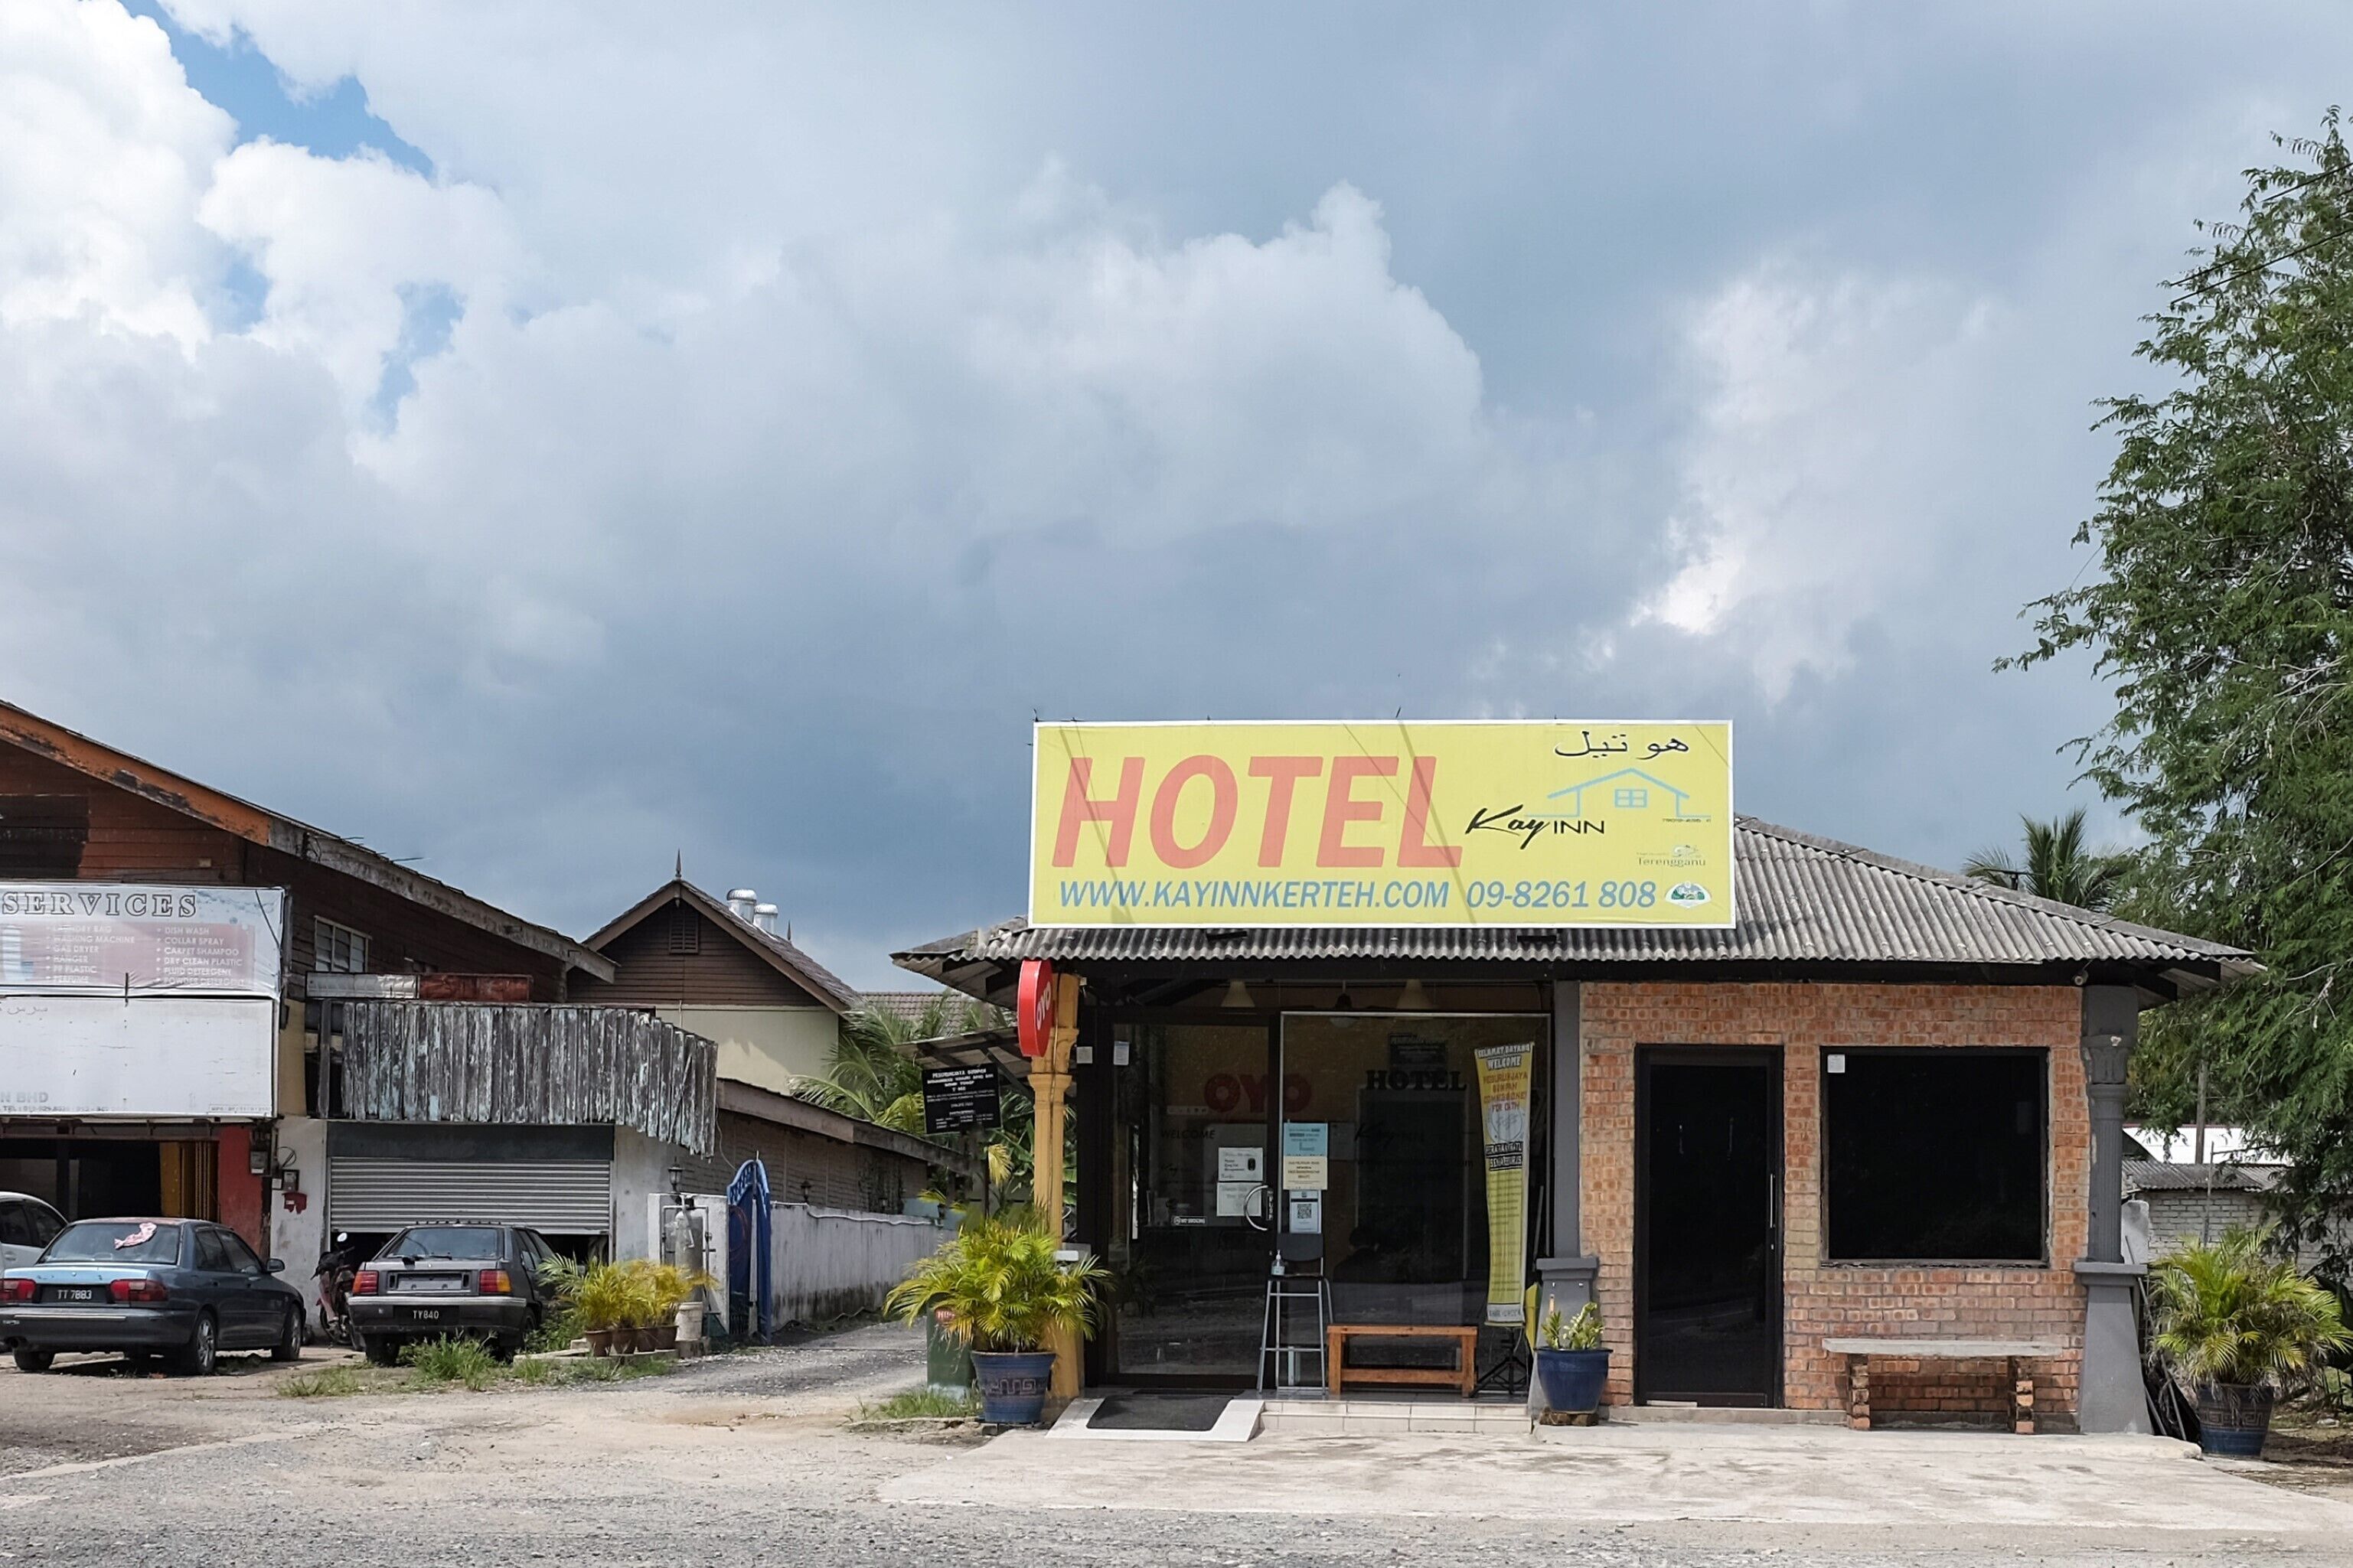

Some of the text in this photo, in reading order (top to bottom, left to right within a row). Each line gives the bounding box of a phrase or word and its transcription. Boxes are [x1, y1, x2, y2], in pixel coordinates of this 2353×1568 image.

[1636, 737, 1690, 760] هو
[1052, 755, 1463, 869] HOTEL
[1464, 804, 1604, 849] Kay INN
[1639, 856, 1706, 867] Terengganu
[2, 892, 196, 918] SERVICES
[1060, 881, 1450, 908] WWW.KAYINNKERTEH.COM
[1466, 881, 1657, 908] 09-8261 808
[65, 966, 97, 974] PLASTIC
[165, 957, 180, 965] DRY
[1036, 981, 1052, 1031] OYO
[1487, 1056, 1521, 1070] WELCOME
[1366, 1069, 1467, 1090] HOTEL
[1204, 1074, 1312, 1113] OYO
[1160, 1129, 1216, 1139] WELCOME
[57, 1289, 92, 1299] TT 7883
[413, 1309, 439, 1319] TY840
